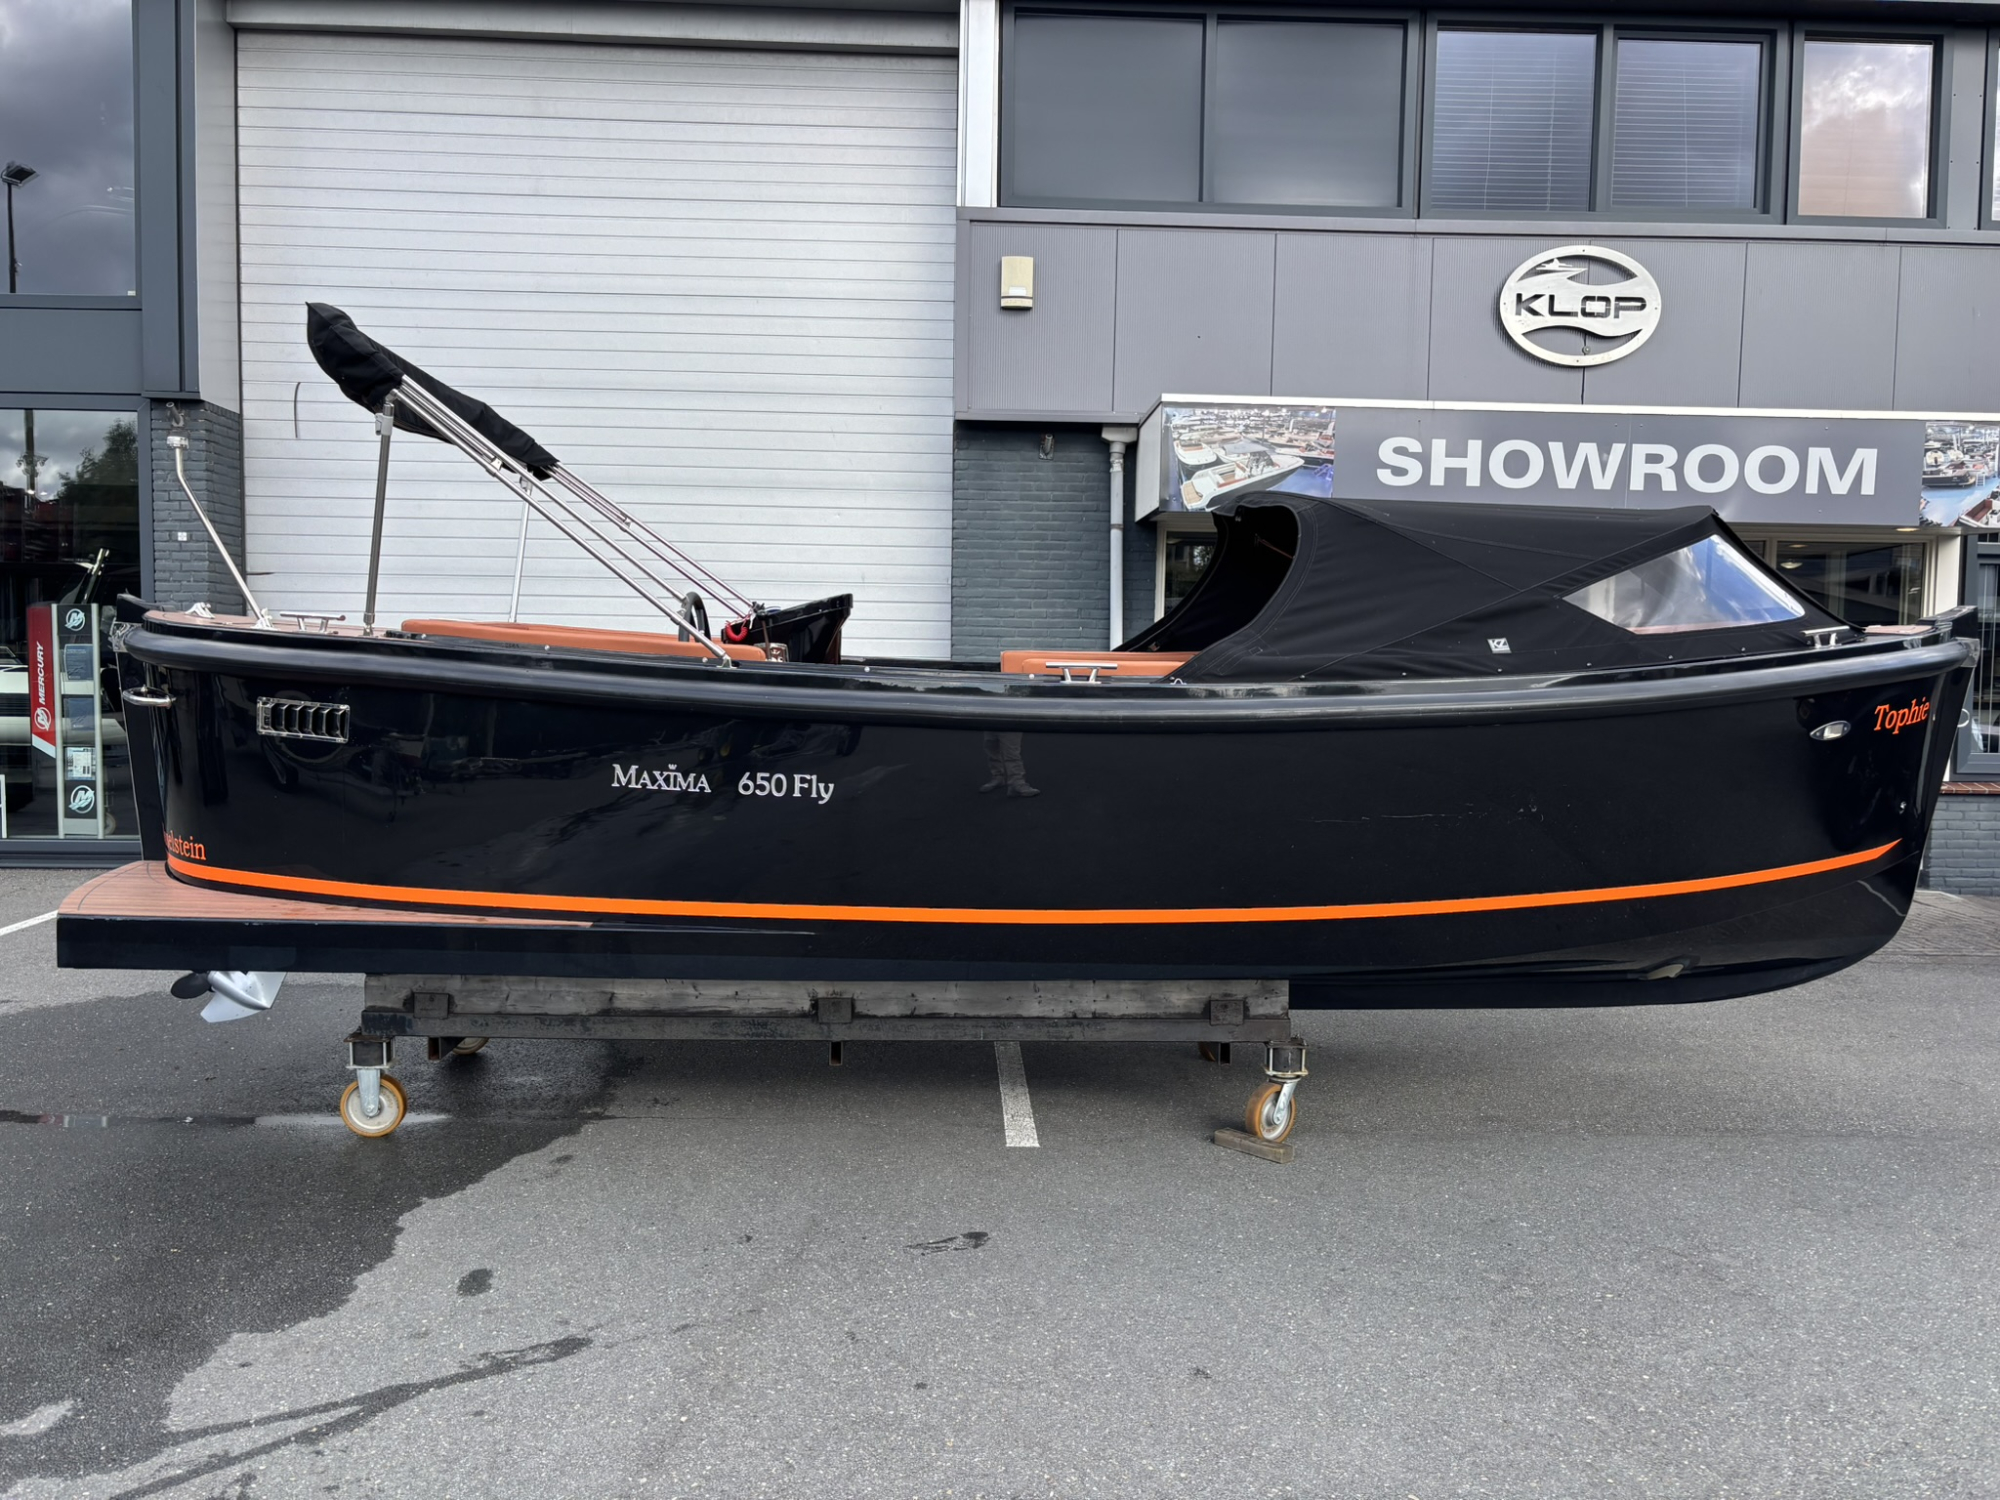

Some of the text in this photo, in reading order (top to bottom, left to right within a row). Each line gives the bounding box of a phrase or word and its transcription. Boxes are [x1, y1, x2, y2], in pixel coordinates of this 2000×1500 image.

[1515, 293, 1647, 319] KLOP
[1377, 436, 1878, 496] SHOWROOM
[36, 641, 46, 705] MERCURY
[1874, 696, 1930, 735] Tophie
[611, 763, 835, 804] MAXIMA 650 Fly
